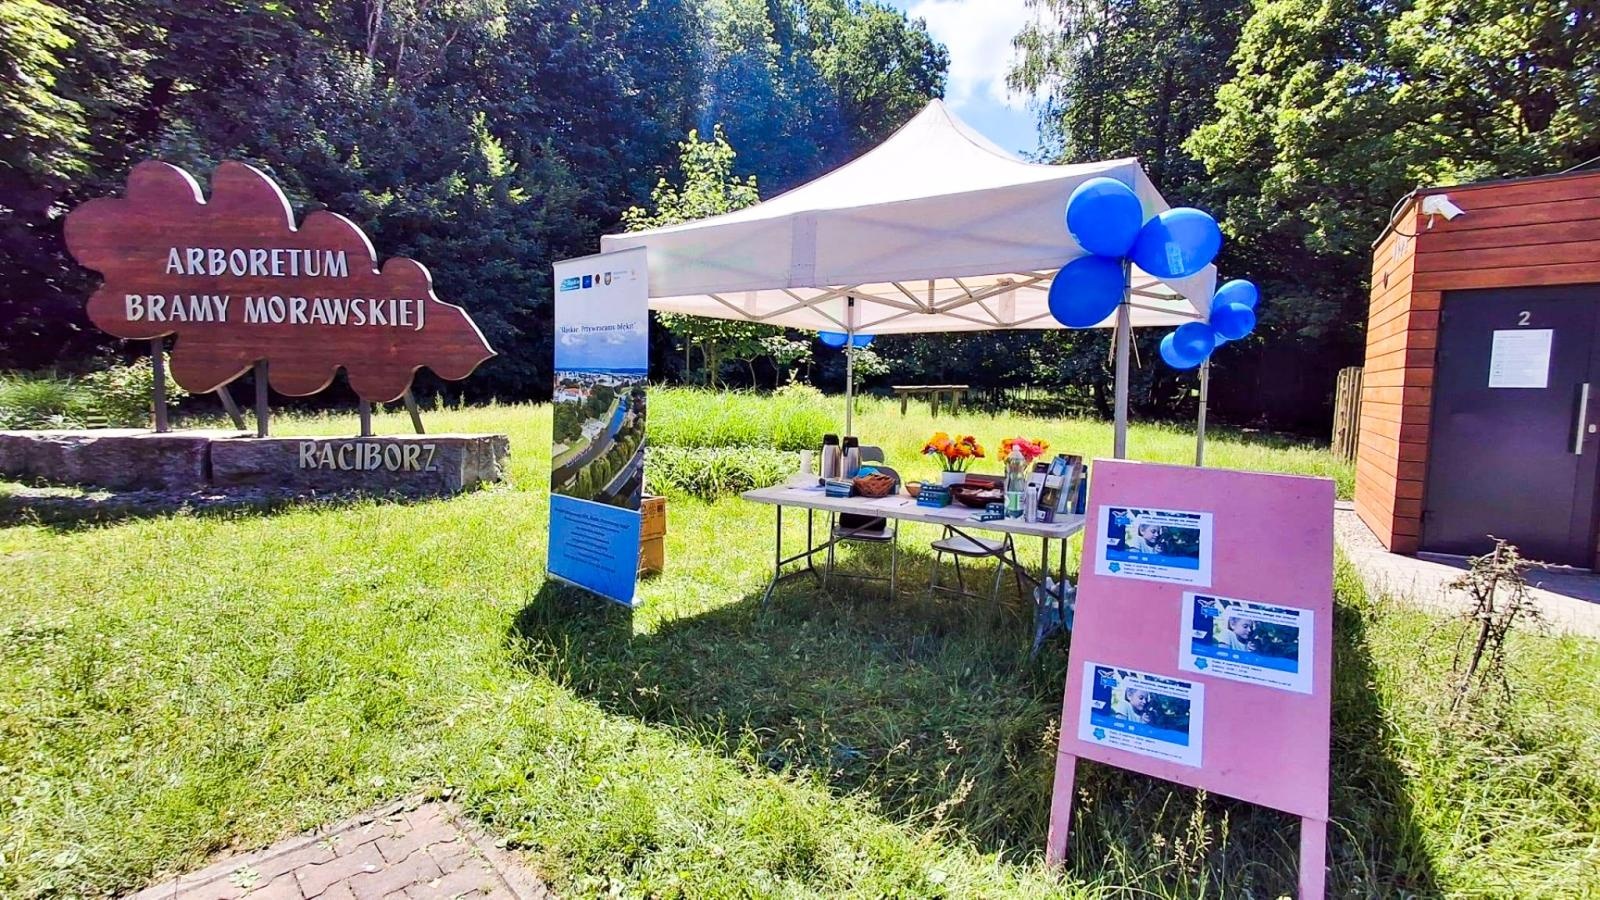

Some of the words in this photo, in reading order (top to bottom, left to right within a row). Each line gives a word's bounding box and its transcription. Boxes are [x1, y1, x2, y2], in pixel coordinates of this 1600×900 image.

[166, 247, 348, 278] ARBORETUM
[125, 294, 229, 322] BRAMY
[244, 295, 425, 331] MORAWSKIEJ
[1518, 310, 1531, 326] 2
[299, 441, 437, 472] RACIBORZ
